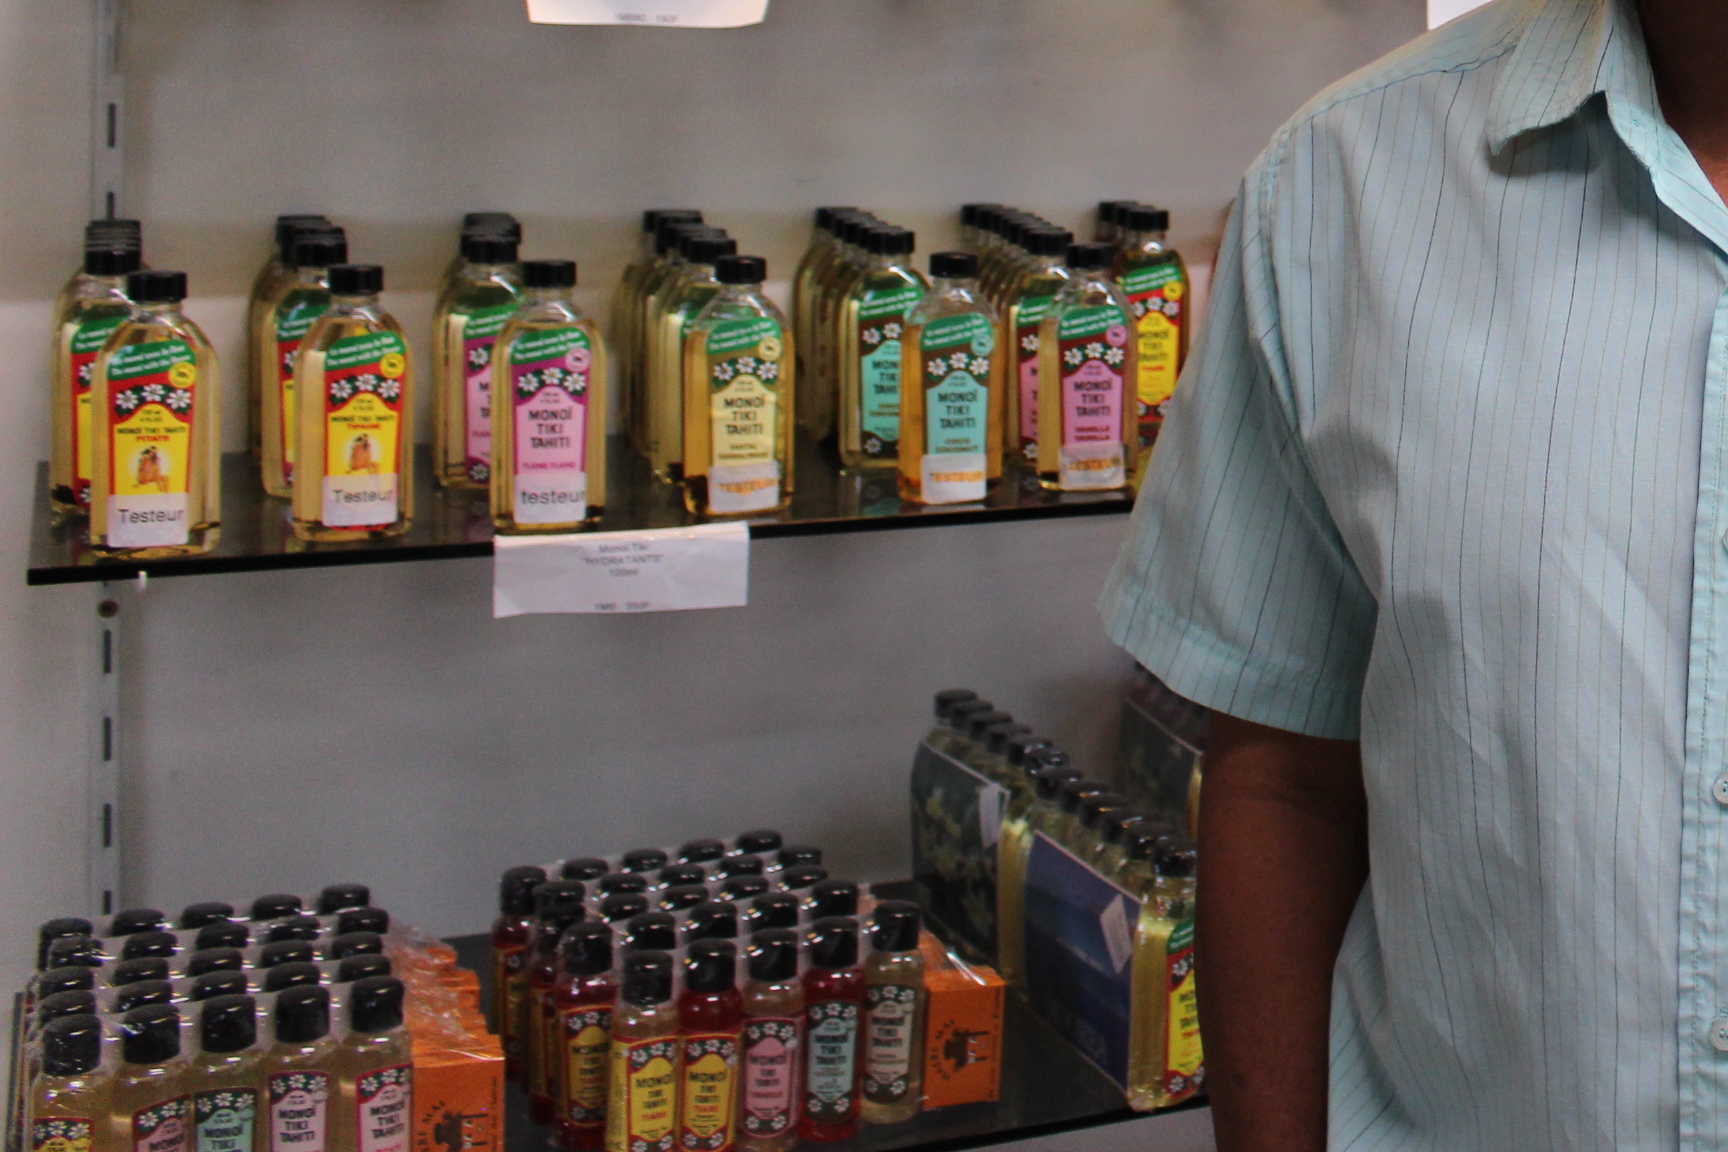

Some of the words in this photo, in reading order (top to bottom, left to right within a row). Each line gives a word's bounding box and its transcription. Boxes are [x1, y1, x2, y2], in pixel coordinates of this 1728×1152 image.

[872, 360, 898, 370] MON
[880, 372, 898, 382] TIK
[938, 390, 978, 402] MONOÏ
[1082, 394, 1104, 404] TIKI
[724, 396, 764, 408] MONOÏ
[528, 406, 572, 420] MONOÏ
[732, 410, 757, 422] TIKI
[946, 406, 970, 416] TIKI
[1076, 406, 1110, 416] TAHITI
[537, 424, 563, 434] TIKI
[940, 418, 976, 429] TAHITI
[726, 424, 763, 435] TAHITI
[530, 436, 570, 448] TAHITI
[332, 488, 392, 504] Testeur
[118, 508, 184, 524] Testeur
[286, 1120, 308, 1130] TIKI
[280, 1130, 315, 1142] TAHITI
